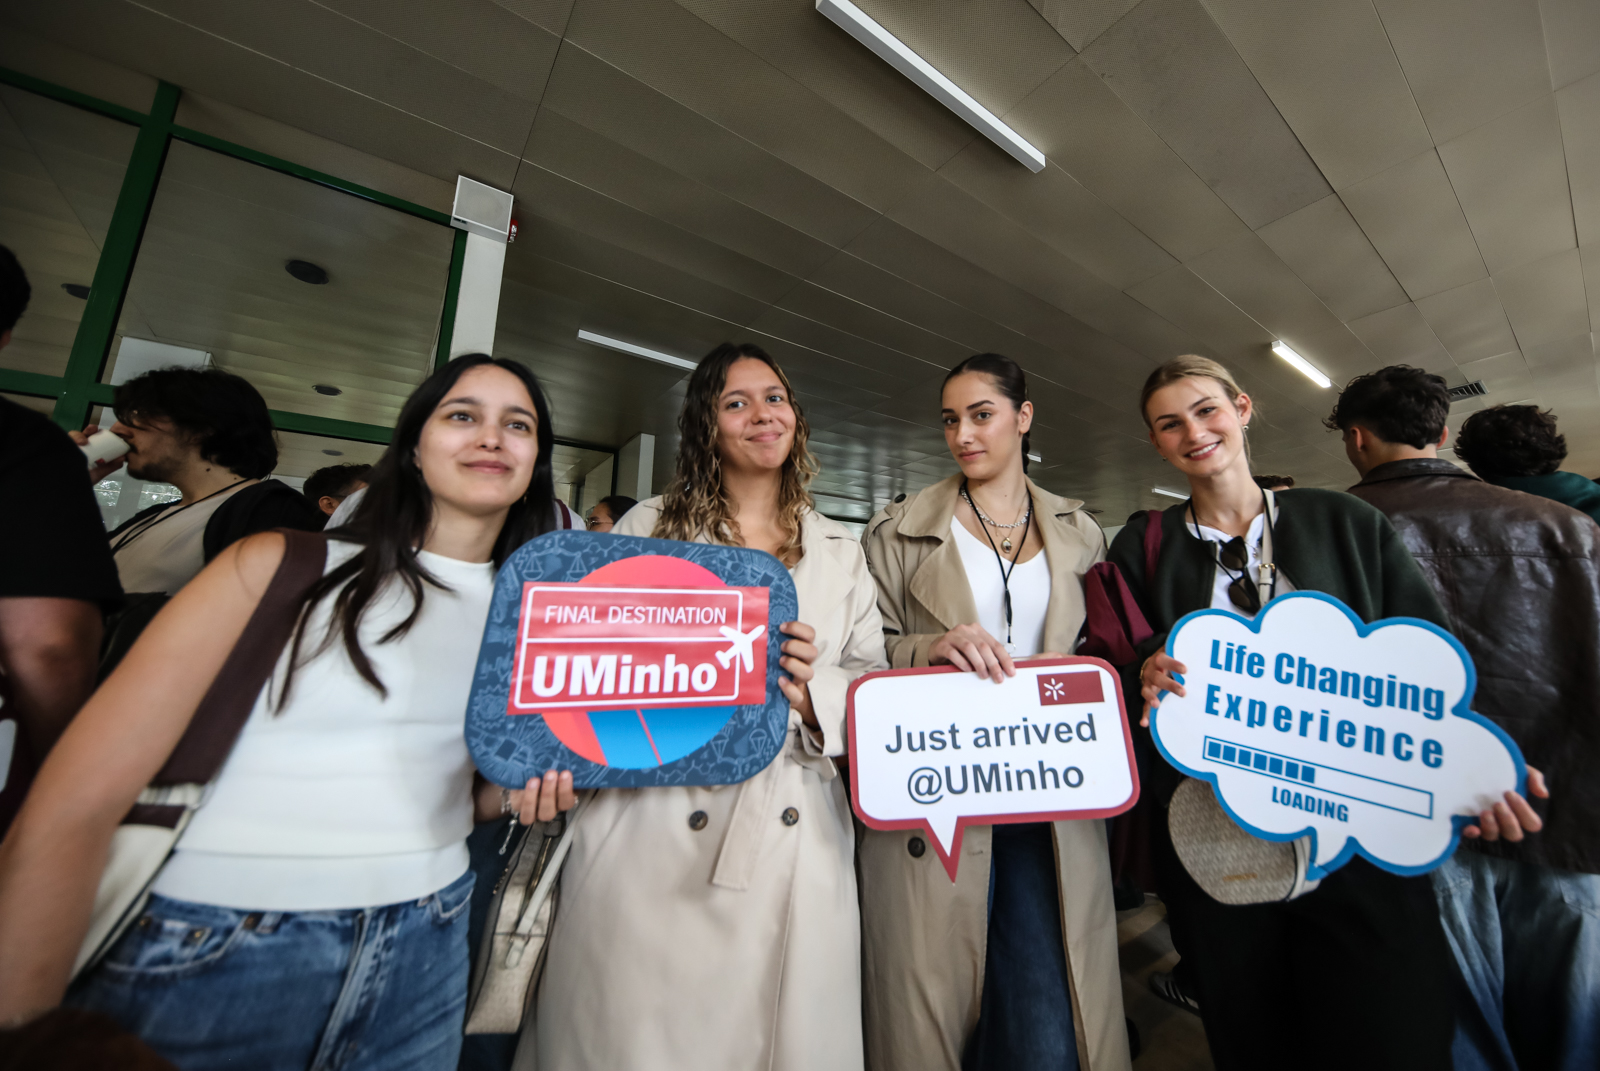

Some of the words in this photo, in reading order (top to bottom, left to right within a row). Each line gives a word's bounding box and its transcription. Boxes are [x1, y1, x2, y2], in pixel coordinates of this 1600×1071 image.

[544, 606, 601, 624] FINAL
[608, 606, 726, 624] DESTINATION
[531, 654, 718, 697] UMinho
[1209, 639, 1265, 679] Life
[1274, 652, 1445, 721] Changing
[885, 722, 962, 754] Just
[972, 713, 1097, 748] arrived
[1204, 684, 1444, 769] Experience
[907, 760, 1085, 805] @UMinho
[1271, 786, 1349, 823] LOADING
